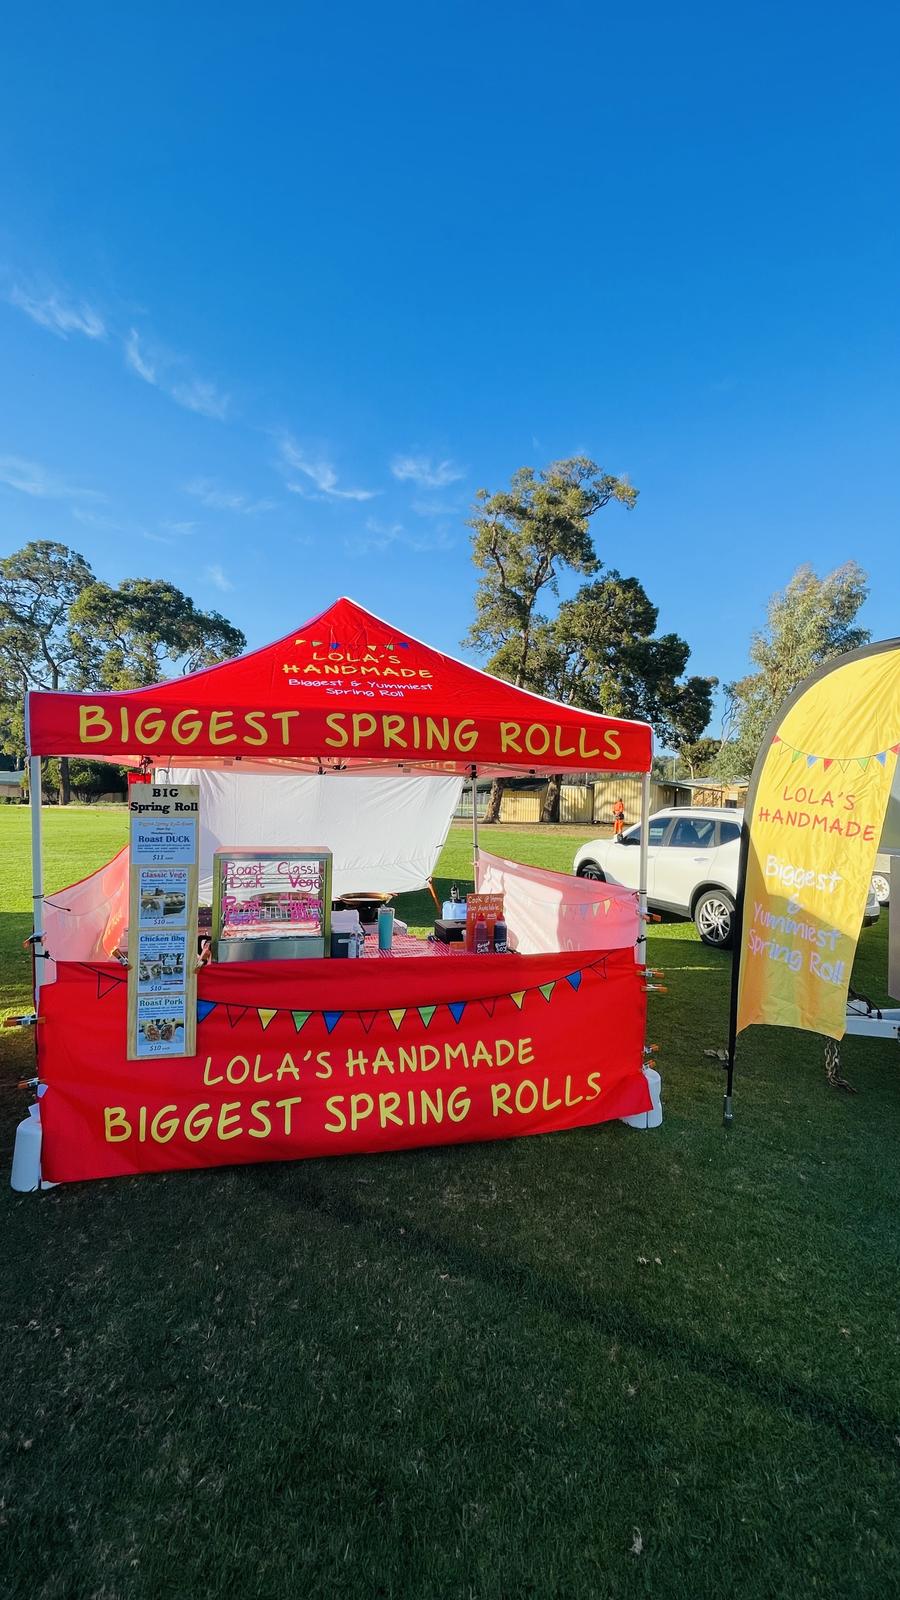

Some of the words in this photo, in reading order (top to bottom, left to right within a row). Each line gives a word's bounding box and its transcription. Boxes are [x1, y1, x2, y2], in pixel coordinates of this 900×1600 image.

[312, 652, 401, 664] LOLA'S
[282, 664, 433, 678] HANDMADE
[288, 678, 344, 687] Biggest
[367, 681, 433, 690] Yummiest
[326, 688, 375, 697] Spring
[79, 704, 300, 746] BIGGEST
[325, 712, 479, 752] SPRING
[500, 721, 622, 761] ROLLS
[152, 788, 179, 797] BIG
[783, 785, 856, 811] LOLA'S
[130, 802, 171, 814] Spring
[174, 802, 199, 811] Roll
[758, 806, 875, 841] HANDMADE
[138, 835, 163, 843] Roast
[165, 835, 190, 843] DUCK
[169, 871, 187, 879] Vege
[224, 861, 265, 875] Roast
[765, 854, 843, 894] Biggest
[229, 875, 265, 888] Duck
[786, 893, 806, 915] &
[753, 902, 842, 951] Yummiest
[747, 928, 804, 971] Spring
[809, 951, 846, 985] Roll
[139, 999, 163, 1007] Roast
[164, 998, 183, 1006] Pork
[203, 1050, 333, 1086] LOLA'S
[346, 1037, 535, 1077] HANDMADE
[104, 1097, 302, 1144] BIGGEST
[324, 1086, 471, 1133] SPRING
[491, 1072, 602, 1117] ROLLS
